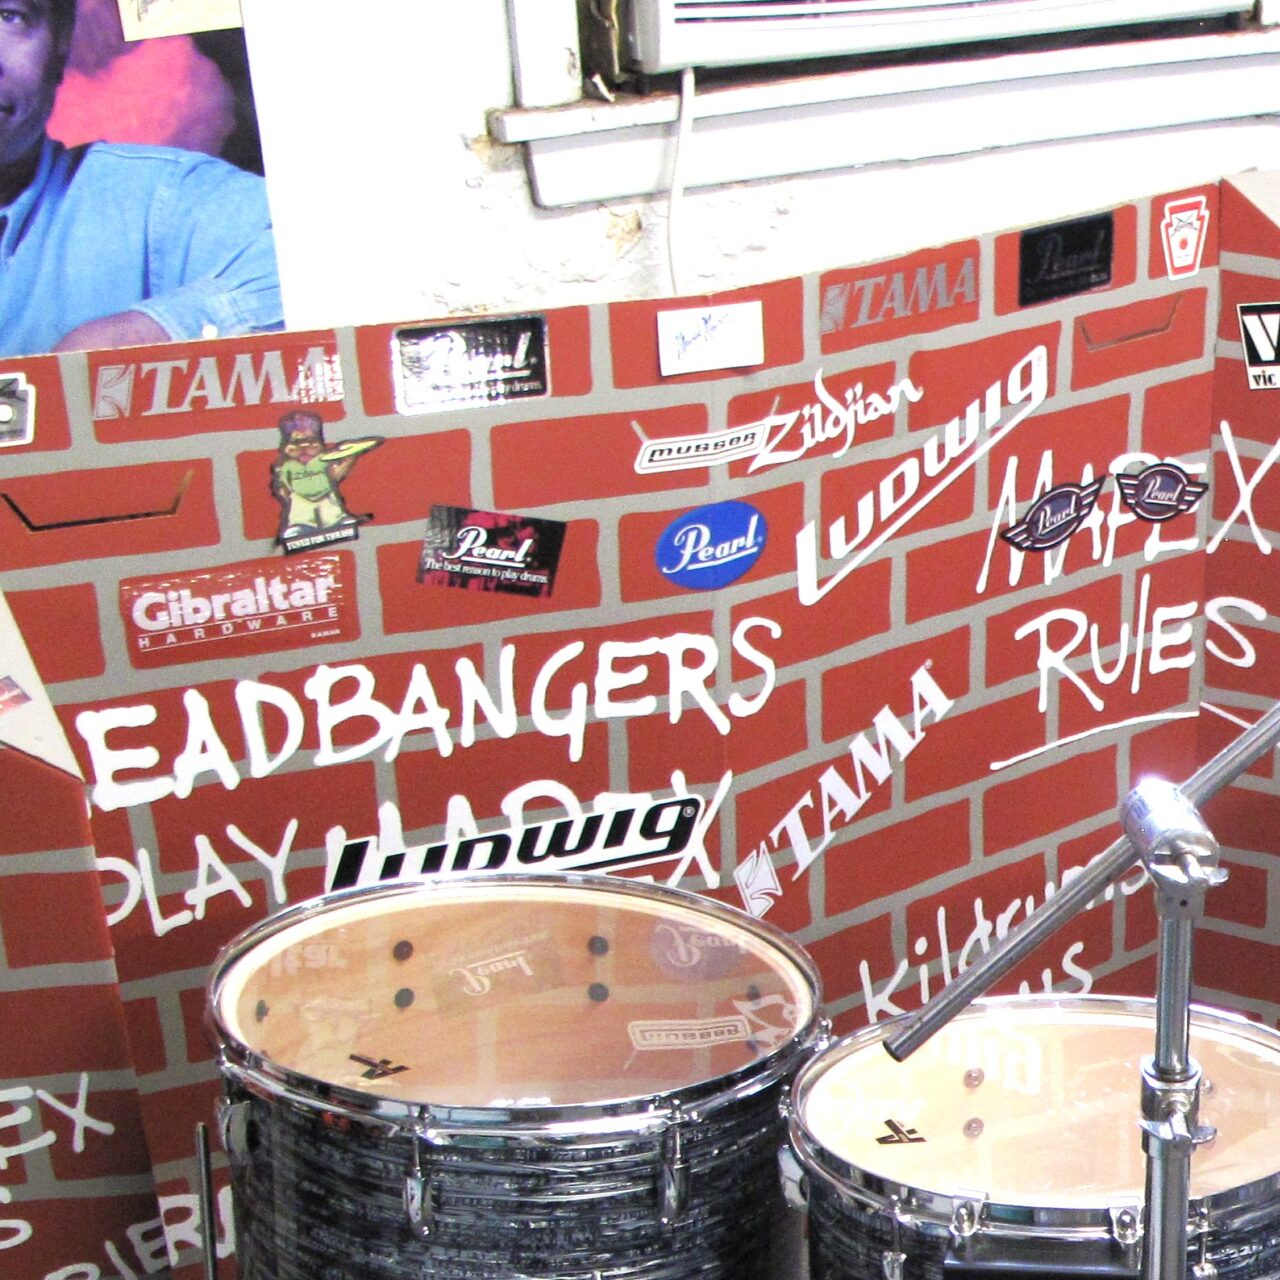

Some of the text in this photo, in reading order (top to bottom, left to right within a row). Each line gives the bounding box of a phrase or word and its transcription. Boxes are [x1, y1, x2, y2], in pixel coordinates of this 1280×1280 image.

[851, 257, 978, 329] TAMA
[140, 345, 344, 417] TAMA
[747, 369, 924, 474] Zildjian
[1037, 495, 1078, 535] Pearl
[1140, 479, 1183, 506] Pearl
[425, 557, 443, 571] The
[443, 560, 462, 573] best
[462, 564, 491, 577] reason
[491, 567, 501, 578] to
[500, 568, 521, 583] play
[442, 525, 535, 568] Pearl
[662, 513, 760, 574] Pearl
[132, 576, 337, 631] Gibraltar
[138, 607, 338, 649] HARDWARE
[76, 617, 782, 812] EADBANGERS
[769, 666, 955, 882] TAMA
